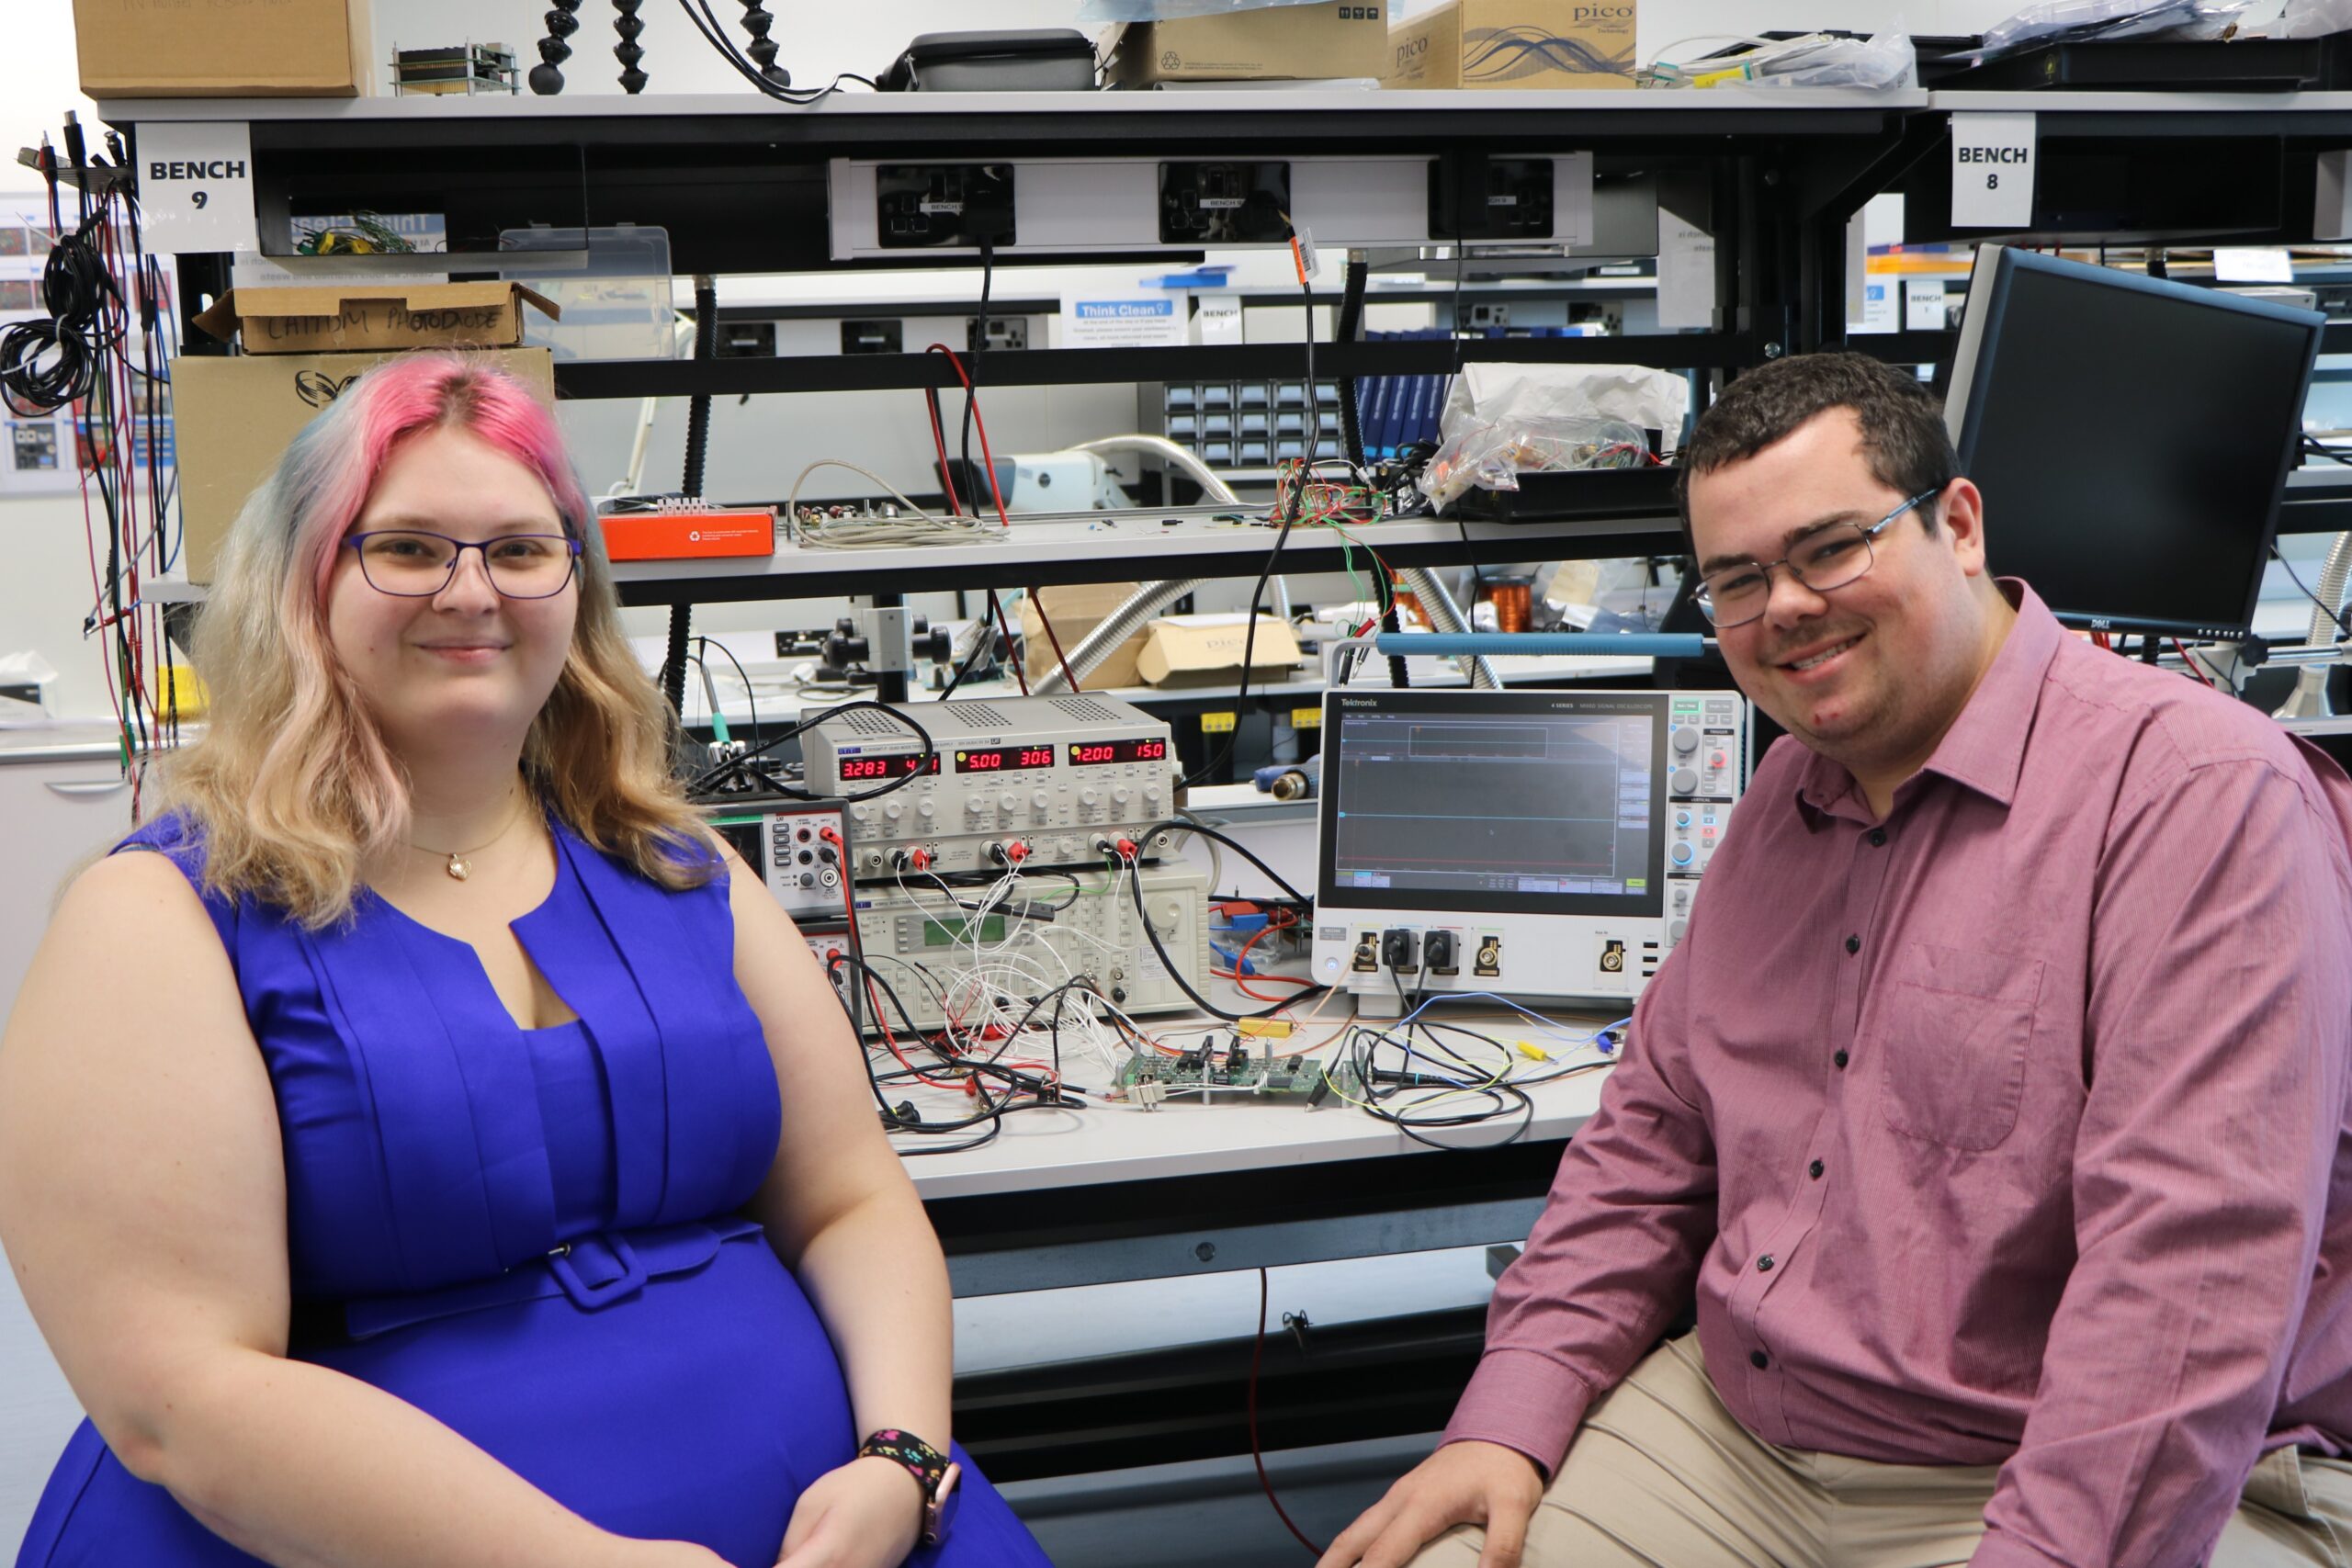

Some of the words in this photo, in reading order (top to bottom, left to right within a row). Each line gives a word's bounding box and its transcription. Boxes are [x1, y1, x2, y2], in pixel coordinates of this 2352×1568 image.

[1573, 3, 1632, 21] pico
[1396, 37, 1428, 68] pico
[1958, 147, 2027, 163] BENCH
[150, 160, 245, 180] BENCH
[1987, 174, 1998, 190] 8
[191, 191, 208, 209] 9
[1082, 305, 1116, 316] Think
[1119, 304, 1155, 316] Clean
[2091, 619, 2110, 629] DELL
[1021, 751, 1051, 765] 306
[1076, 747, 1114, 761] 12.00
[1138, 744, 1163, 757] 150
[844, 761, 887, 777] 3.283
[970, 754, 1001, 768] 5.00
